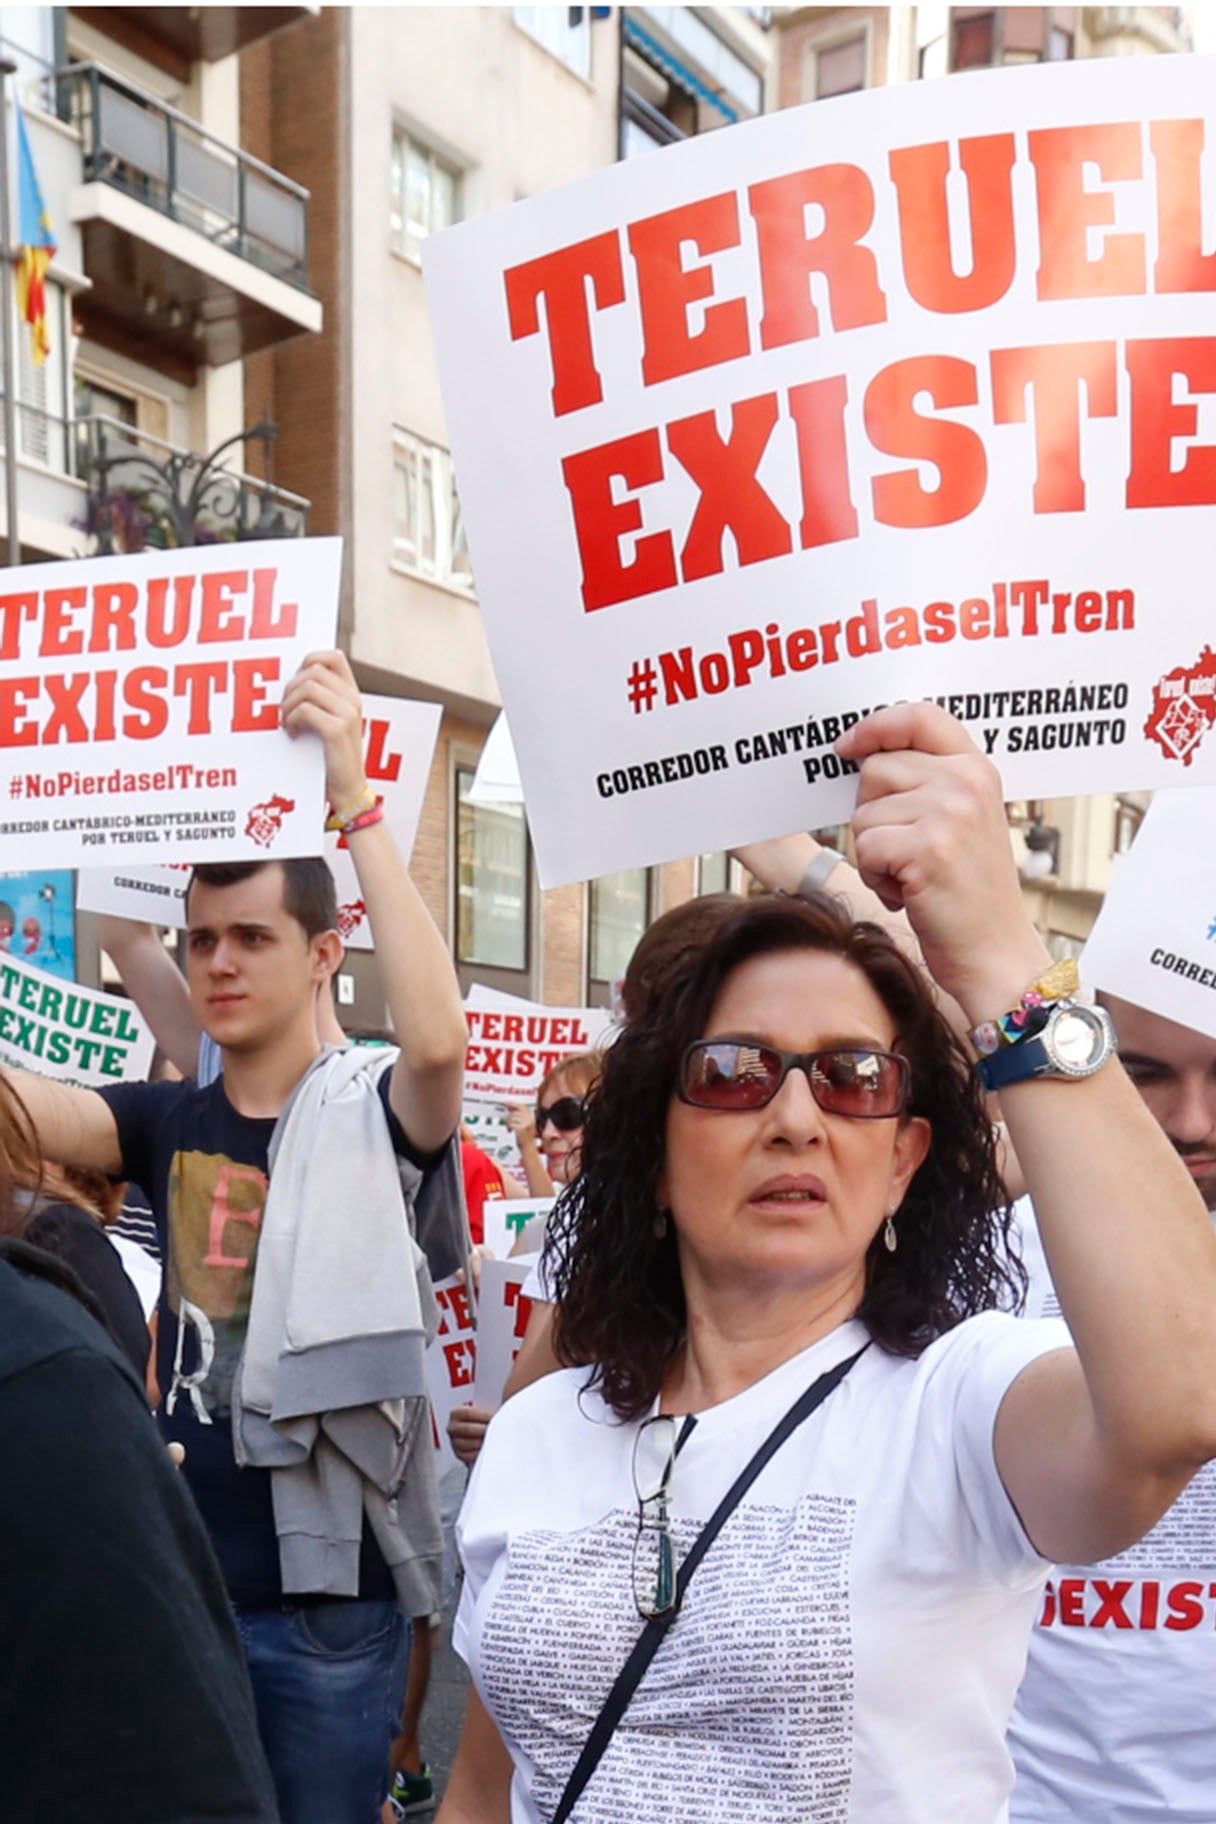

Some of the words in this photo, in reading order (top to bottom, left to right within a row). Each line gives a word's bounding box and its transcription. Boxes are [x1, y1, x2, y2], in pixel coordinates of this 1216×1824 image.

[0, 567, 298, 661] TERUEL
[627, 579, 1137, 714] #NoPierdaselTren
[0, 657, 281, 749] EXISTE
[597, 744, 729, 798] CORREDOR
[735, 680, 1129, 765] CANTÁBREDITERRÁNEO
[983, 728, 1001, 755] Y
[1007, 718, 1127, 754] SAGUNTO
[9, 764, 238, 800] #NoPierdaselTren
[53, 809, 236, 831] CANTÁBRICO-MEDITERRÁNEO
[82, 832, 105, 845] POR
[110, 830, 160, 845] TERUEL
[164, 830, 172, 841] Y
[176, 827, 236, 841] SAGUNTO
[114, 876, 171, 897] CORREDOR
[0, 964, 139, 1043] TERUEL
[0, 1005, 128, 1077] EXISTE
[465, 1011, 589, 1046] TERUEL
[465, 1046, 580, 1077] EXIST
